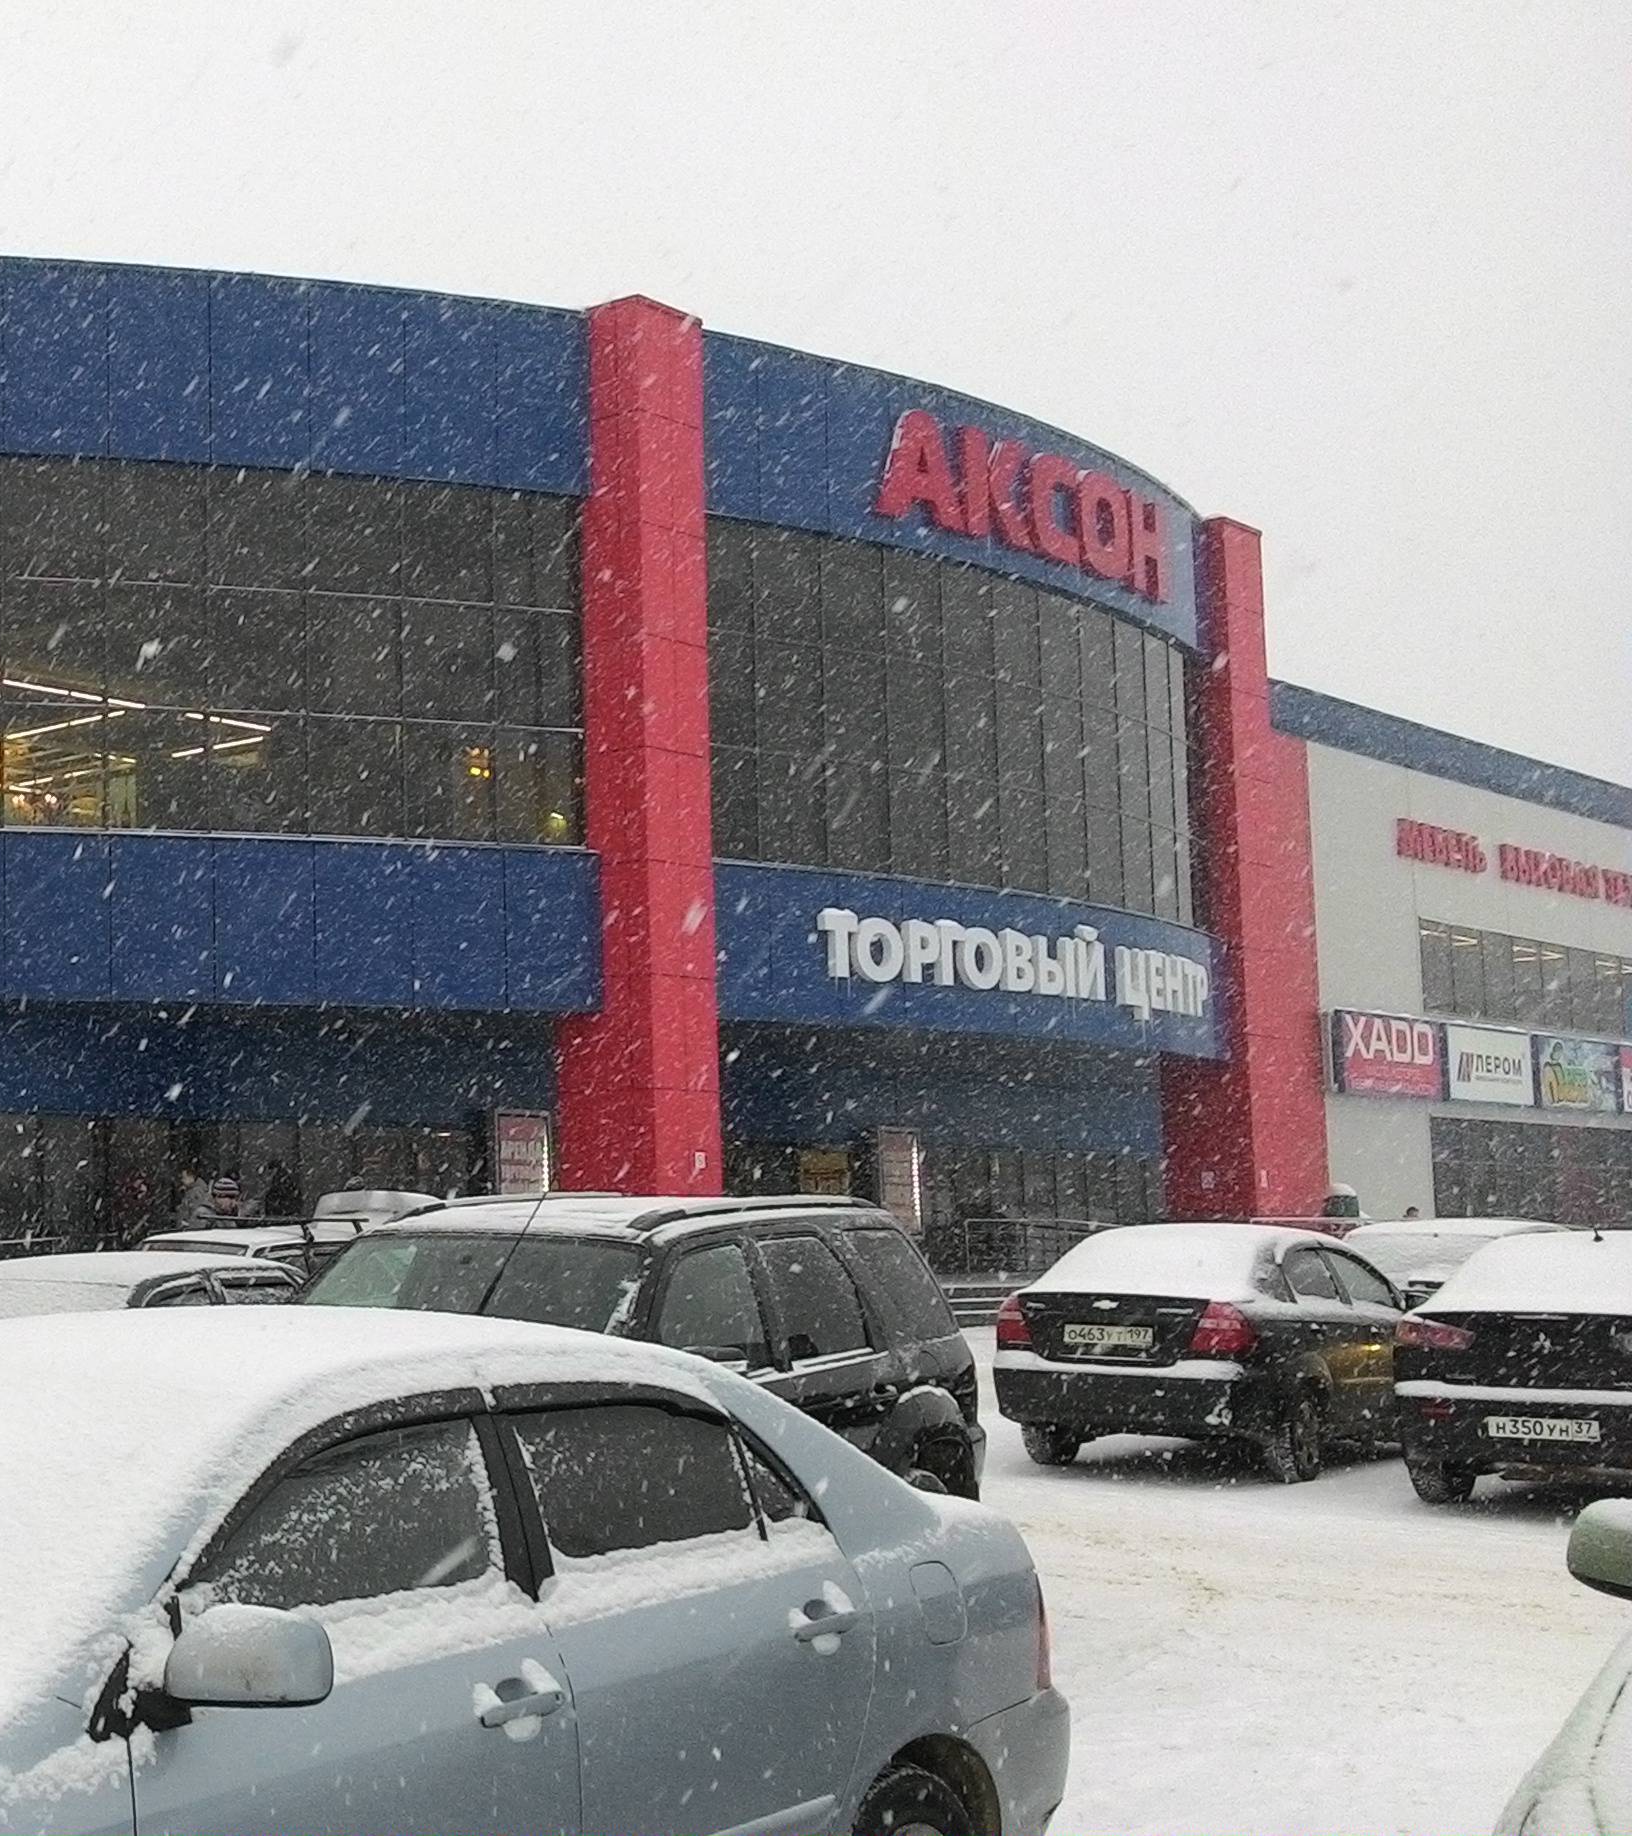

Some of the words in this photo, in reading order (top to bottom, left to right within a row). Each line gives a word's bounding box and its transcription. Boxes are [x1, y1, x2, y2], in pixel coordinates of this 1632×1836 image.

[875, 408, 1167, 604] АКСОН
[817, 907, 1106, 1003] ТОРГОВЫЙ
[1114, 945, 1208, 1021] ЦЕНТР
[1344, 1013, 1434, 1066] XADO
